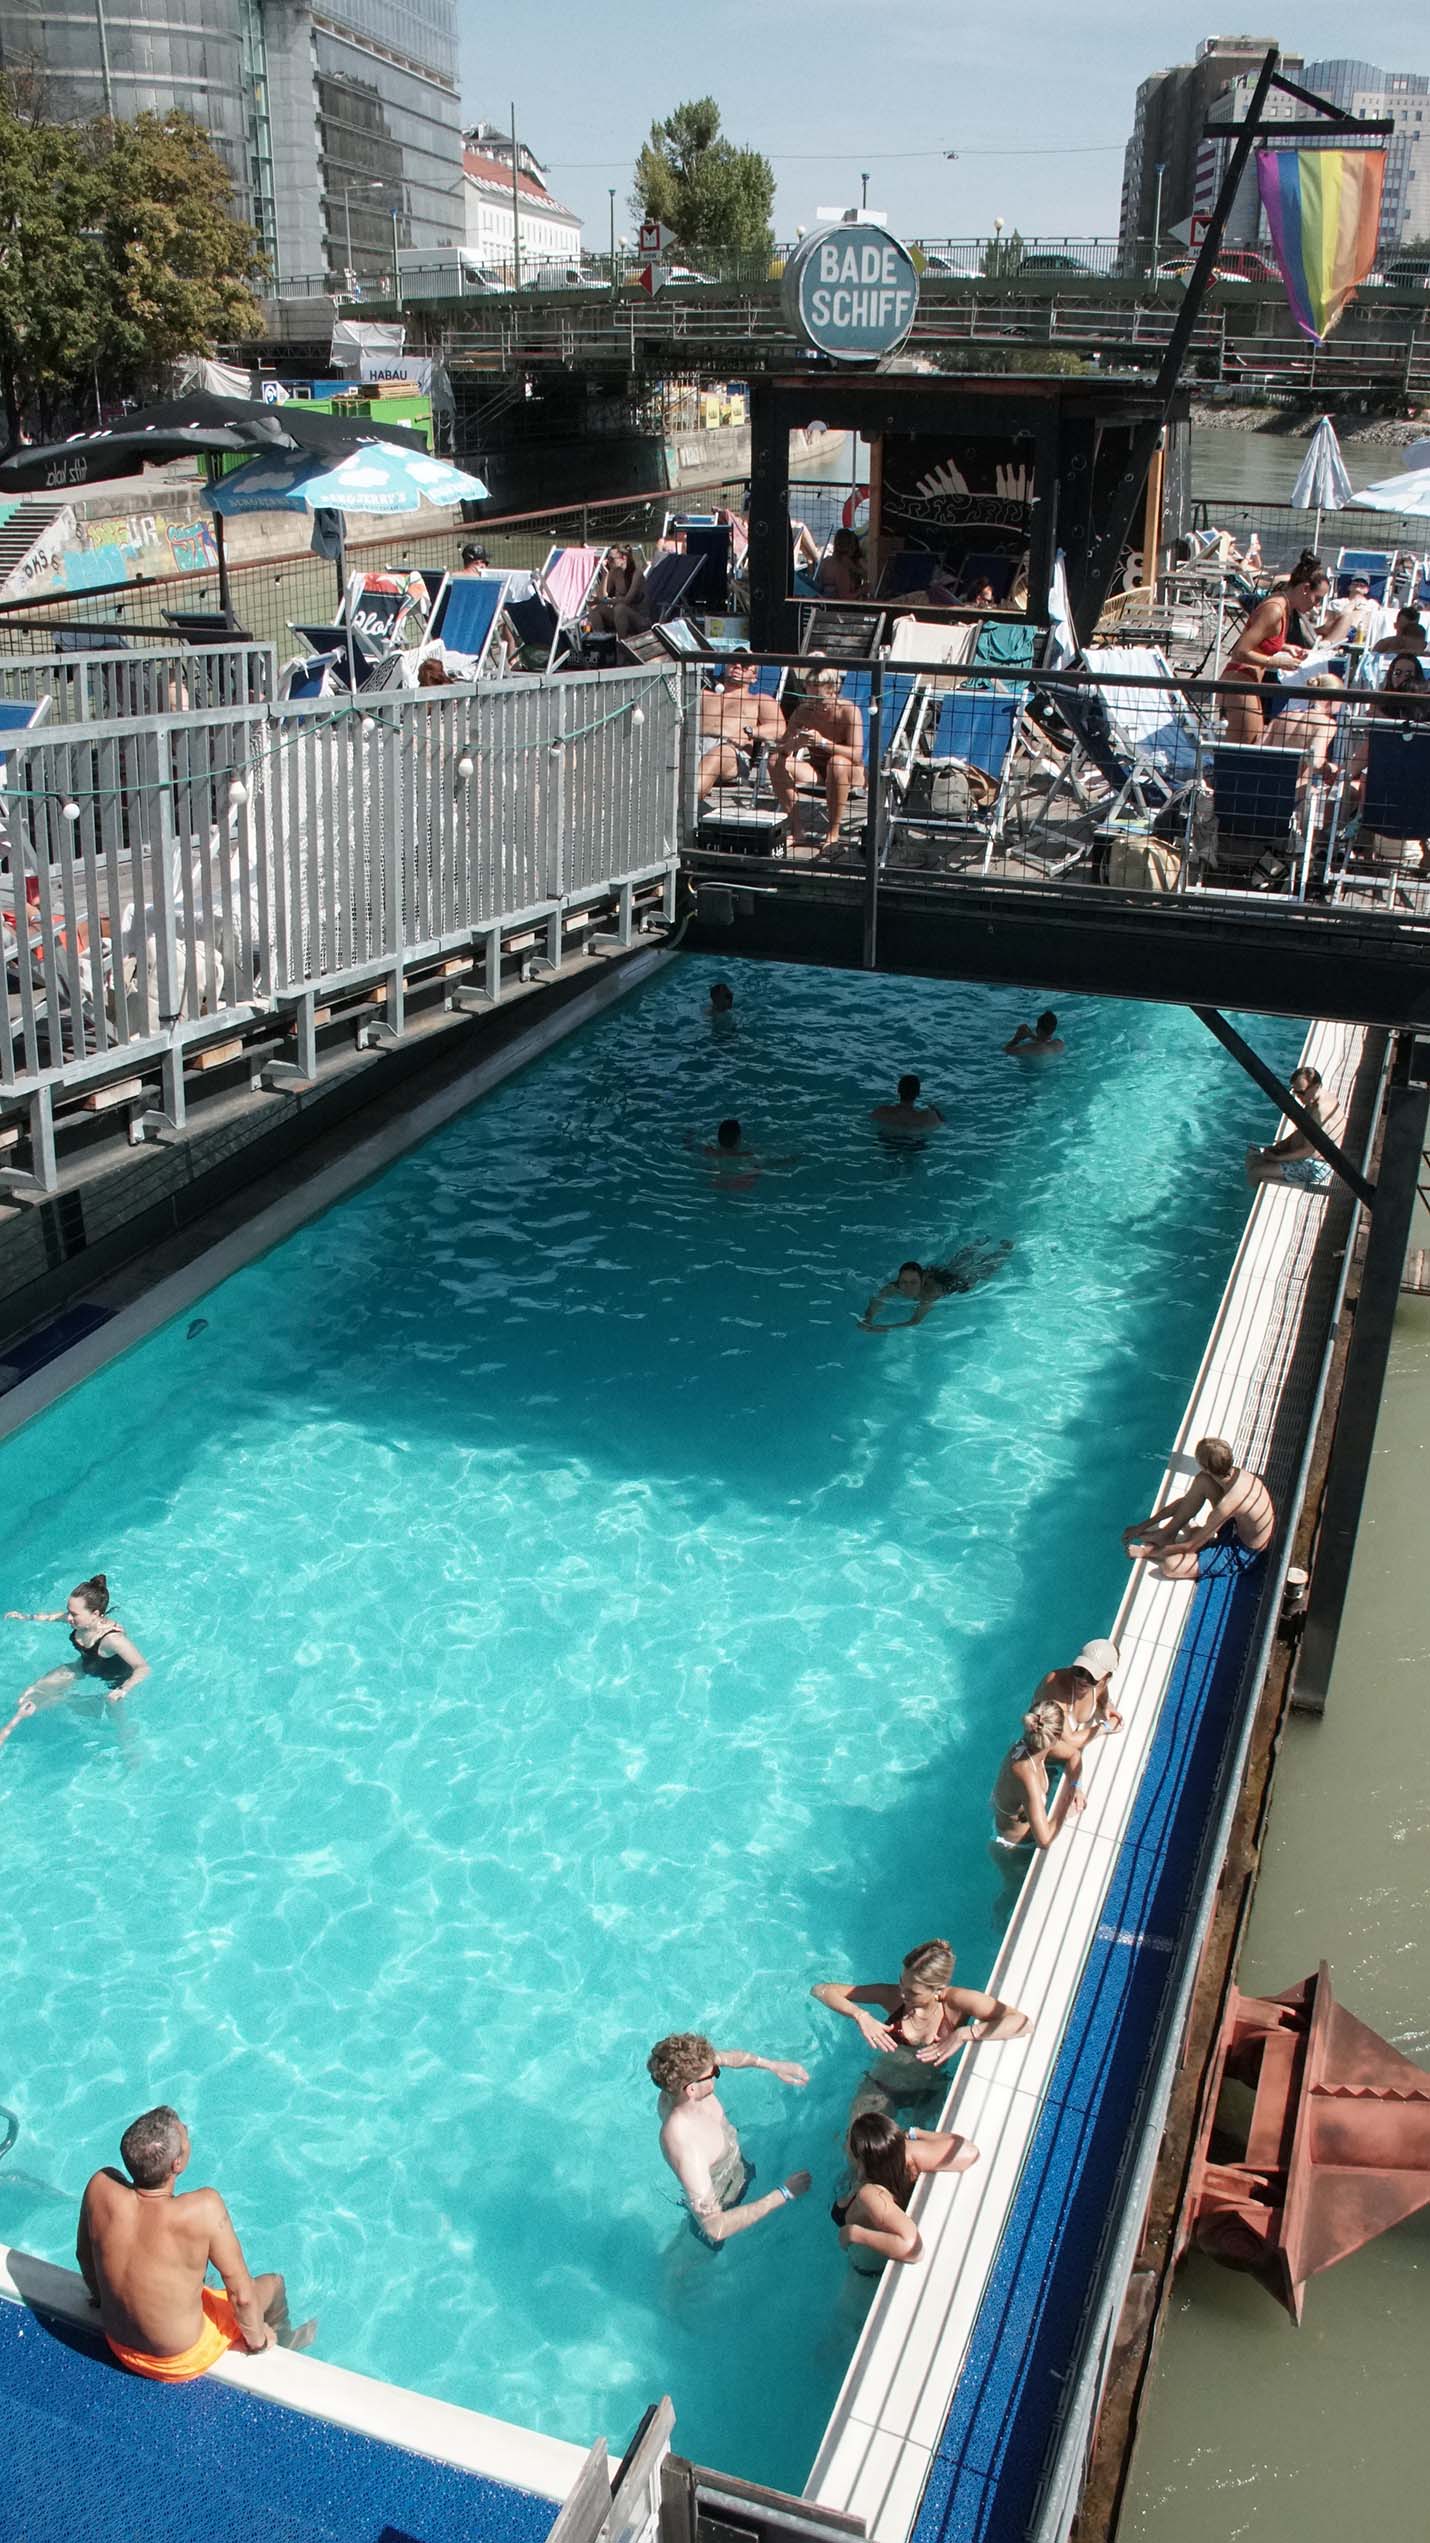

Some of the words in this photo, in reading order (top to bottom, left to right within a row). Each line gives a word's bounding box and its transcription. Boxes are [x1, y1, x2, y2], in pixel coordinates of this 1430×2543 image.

[820, 244, 898, 284] BADE
[811, 289, 912, 328] SCHIFF
[369, 369, 408, 381] HABAU
